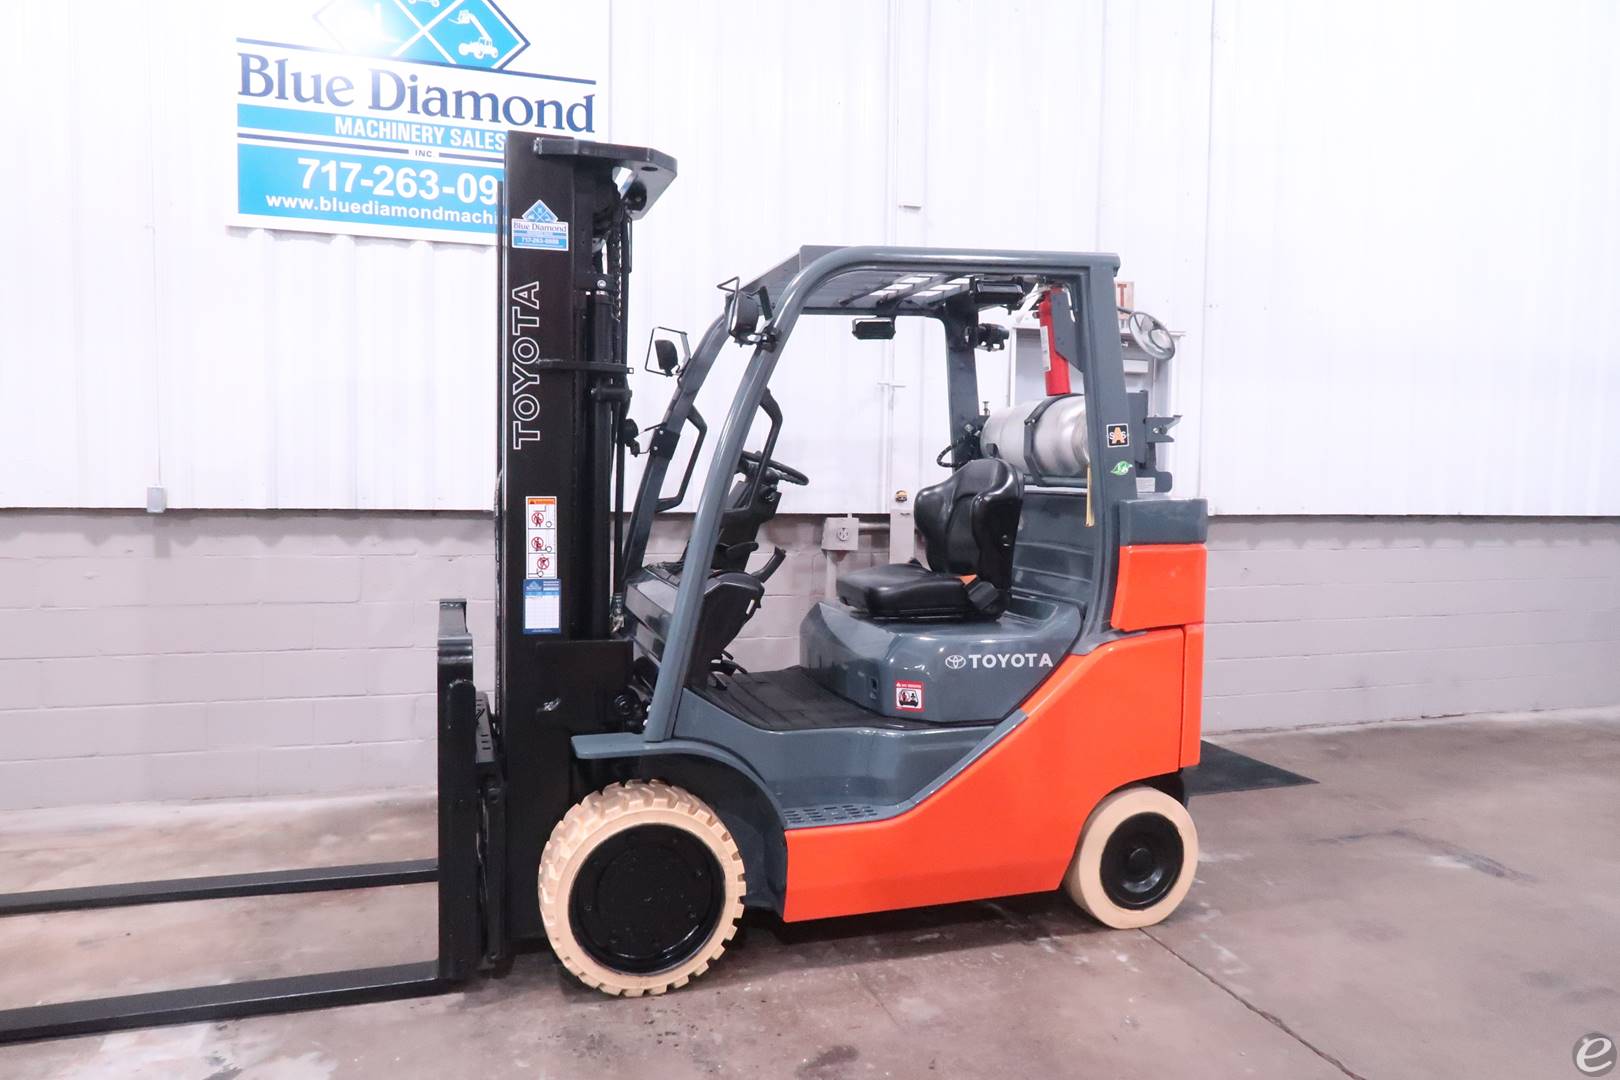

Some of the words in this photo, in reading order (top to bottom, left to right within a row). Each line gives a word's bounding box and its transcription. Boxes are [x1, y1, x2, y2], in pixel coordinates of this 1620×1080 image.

[238, 53, 354, 107] Blue
[368, 68, 595, 133] Diamond
[335, 116, 446, 145] MACHINERY
[450, 128, 506, 151] SALES
[512, 281, 540, 450] TOYOTA
[968, 653, 1054, 669] TOYOTA
